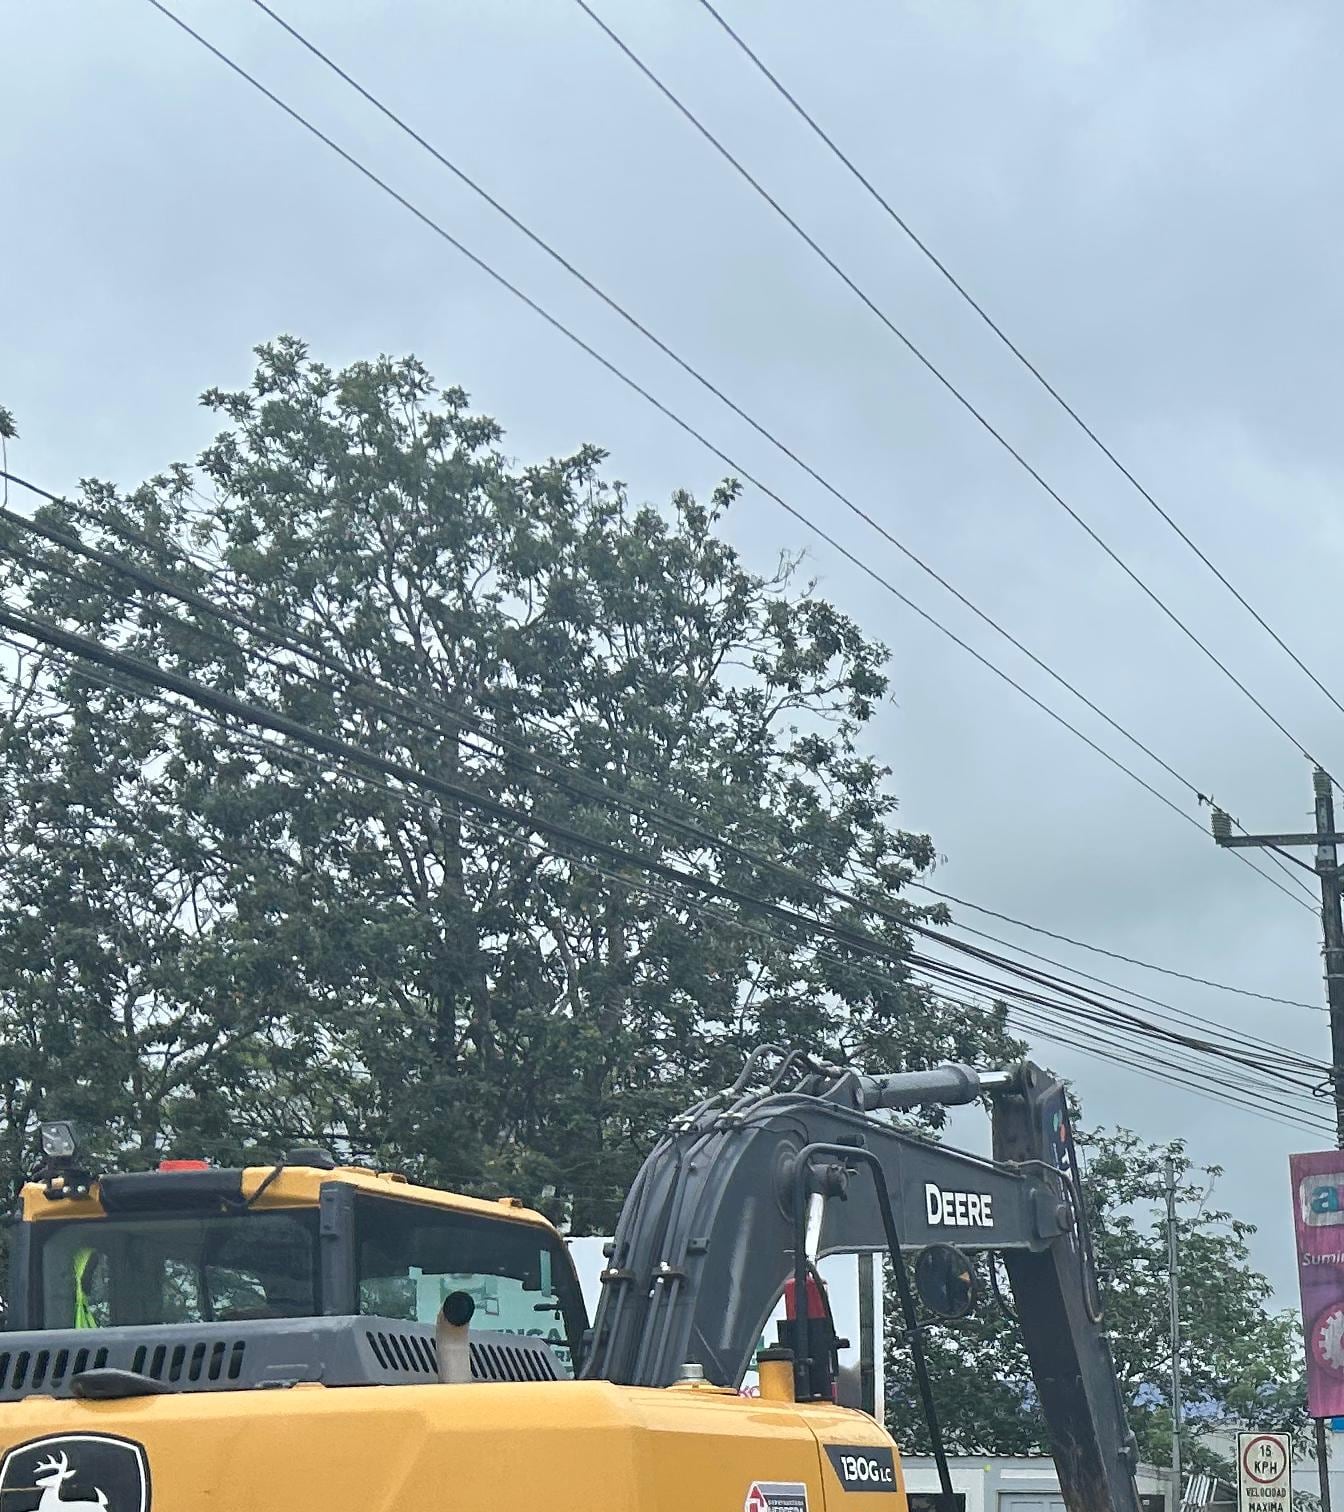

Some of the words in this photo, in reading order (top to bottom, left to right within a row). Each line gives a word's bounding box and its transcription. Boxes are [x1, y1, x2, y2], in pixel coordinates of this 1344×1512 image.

[925, 1183, 994, 1227] DEERE
[1260, 1445, 1271, 1457] 15
[841, 1456, 879, 1481] 130G
[880, 1468, 892, 1482] LC
[1254, 1461, 1277, 1474] KPH
[1246, 1487, 1286, 1498] VELOCIDAD
[1249, 1502, 1283, 1512] MAXIMA
